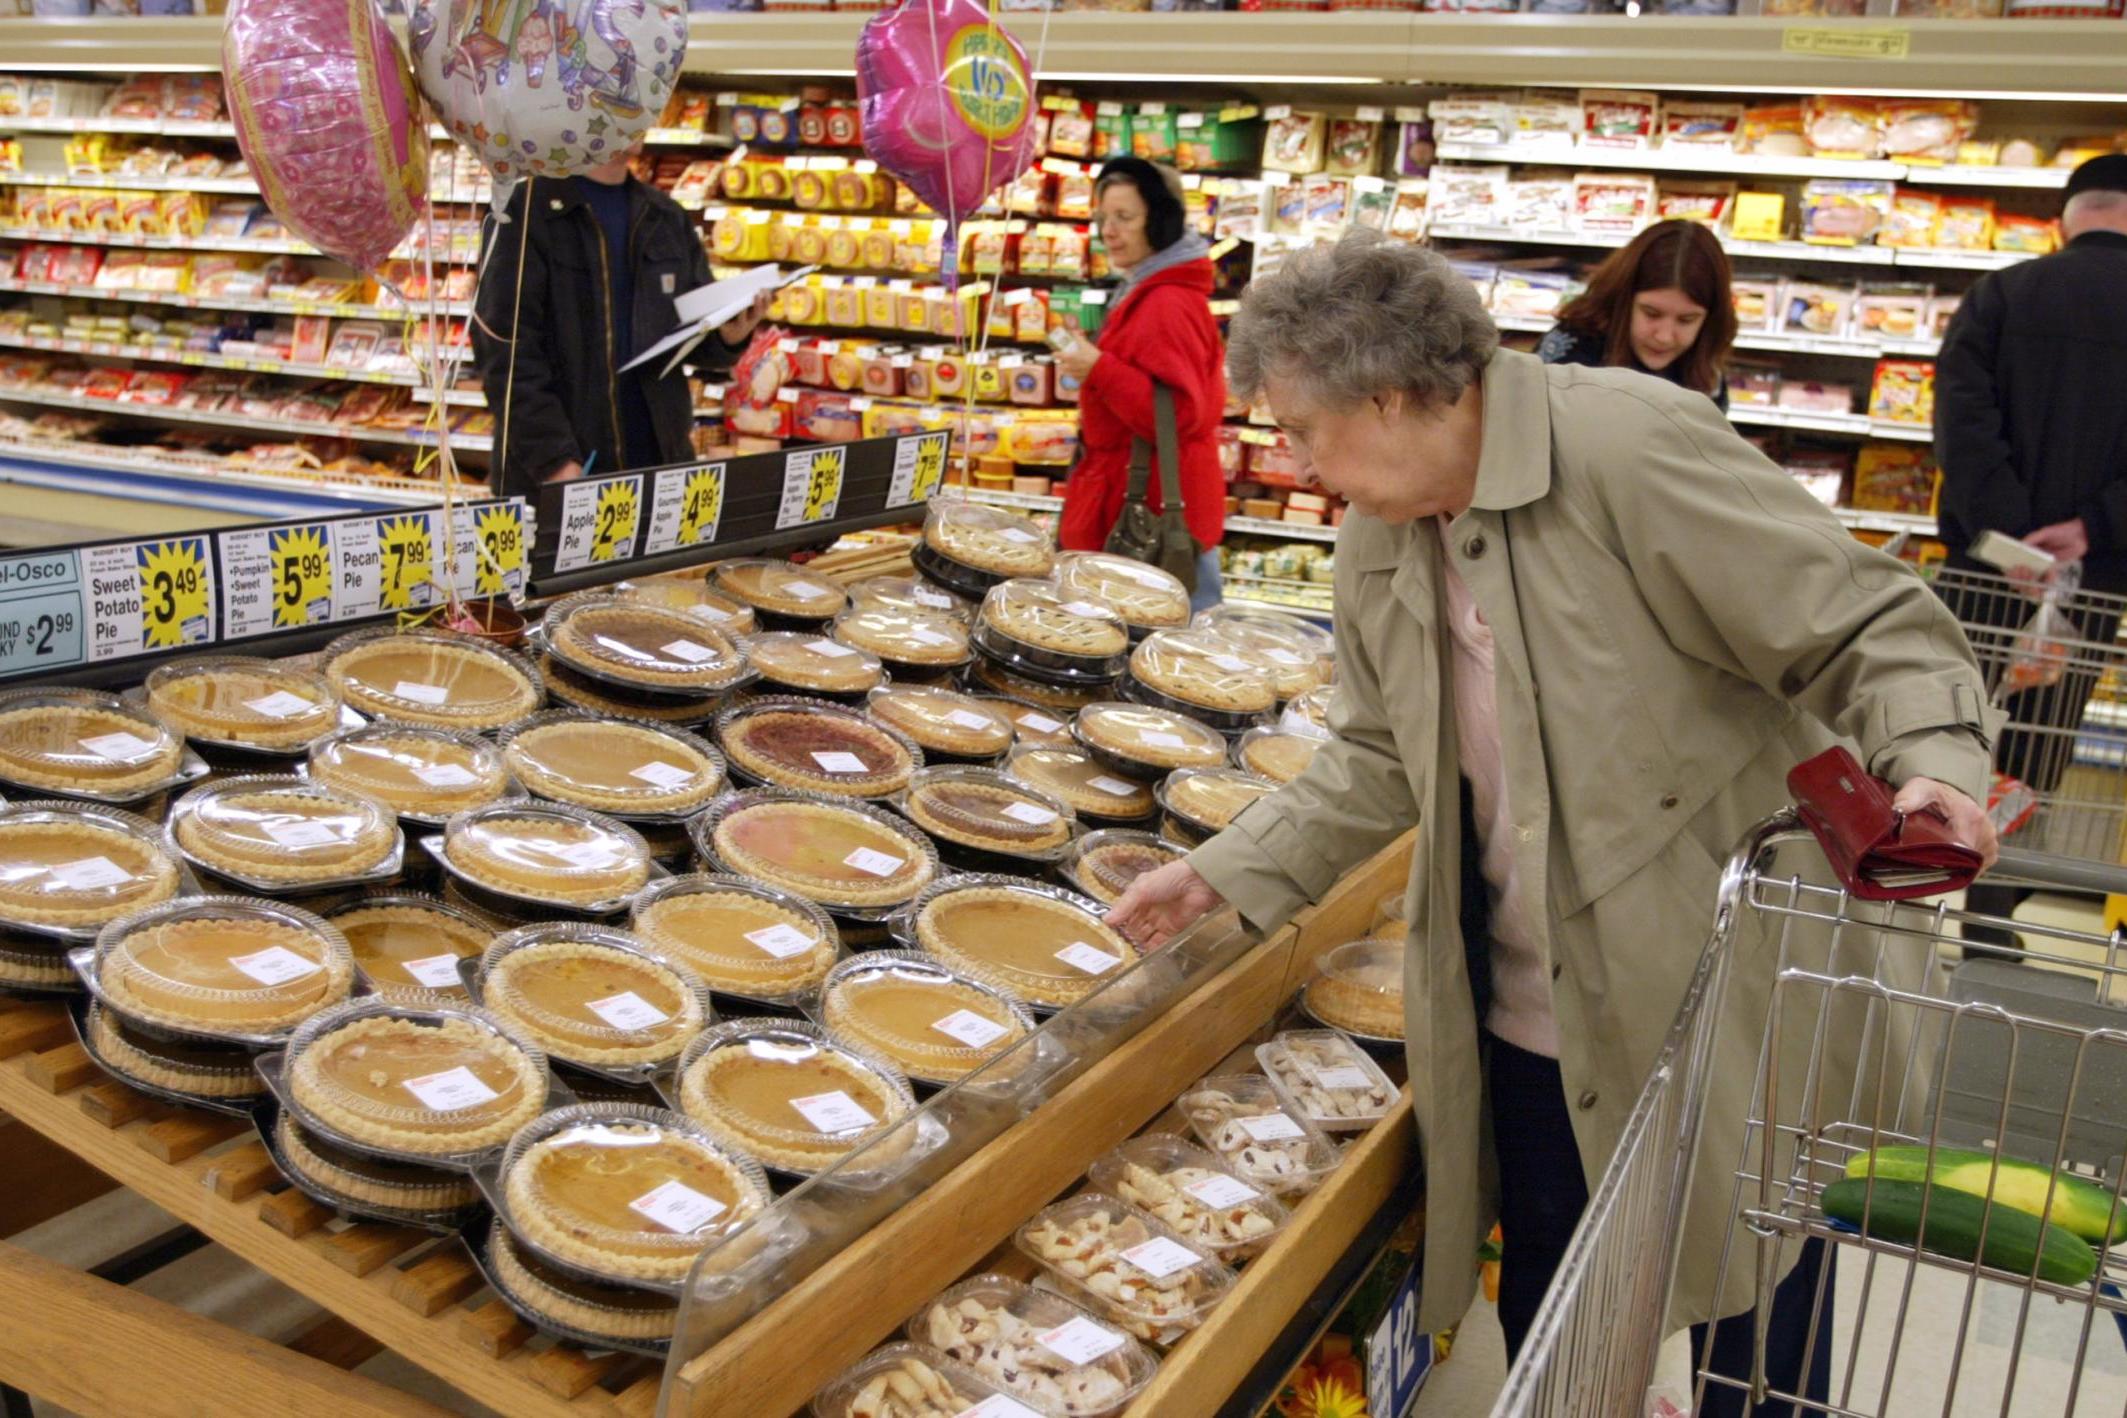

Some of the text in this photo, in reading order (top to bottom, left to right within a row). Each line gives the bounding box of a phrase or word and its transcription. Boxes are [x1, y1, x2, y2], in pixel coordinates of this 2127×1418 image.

[687, 488, 714, 528] 499
[566, 512, 595, 532] Apple
[600, 501, 630, 545] 299
[564, 534, 580, 551] Pie
[343, 552, 379, 568] Pecan
[390, 541, 425, 589] 799
[0, 562, 66, 583] l-Osco
[283, 554, 322, 606] 599
[344, 572, 362, 589] Pie
[93, 576, 136, 596] Sweet
[235, 579, 260, 591] Sweet
[153, 567, 197, 624] 349
[231, 594, 258, 606] Potato
[95, 598, 140, 618] Potato
[231, 609, 245, 619] Pie
[96, 622, 118, 640] Pie
